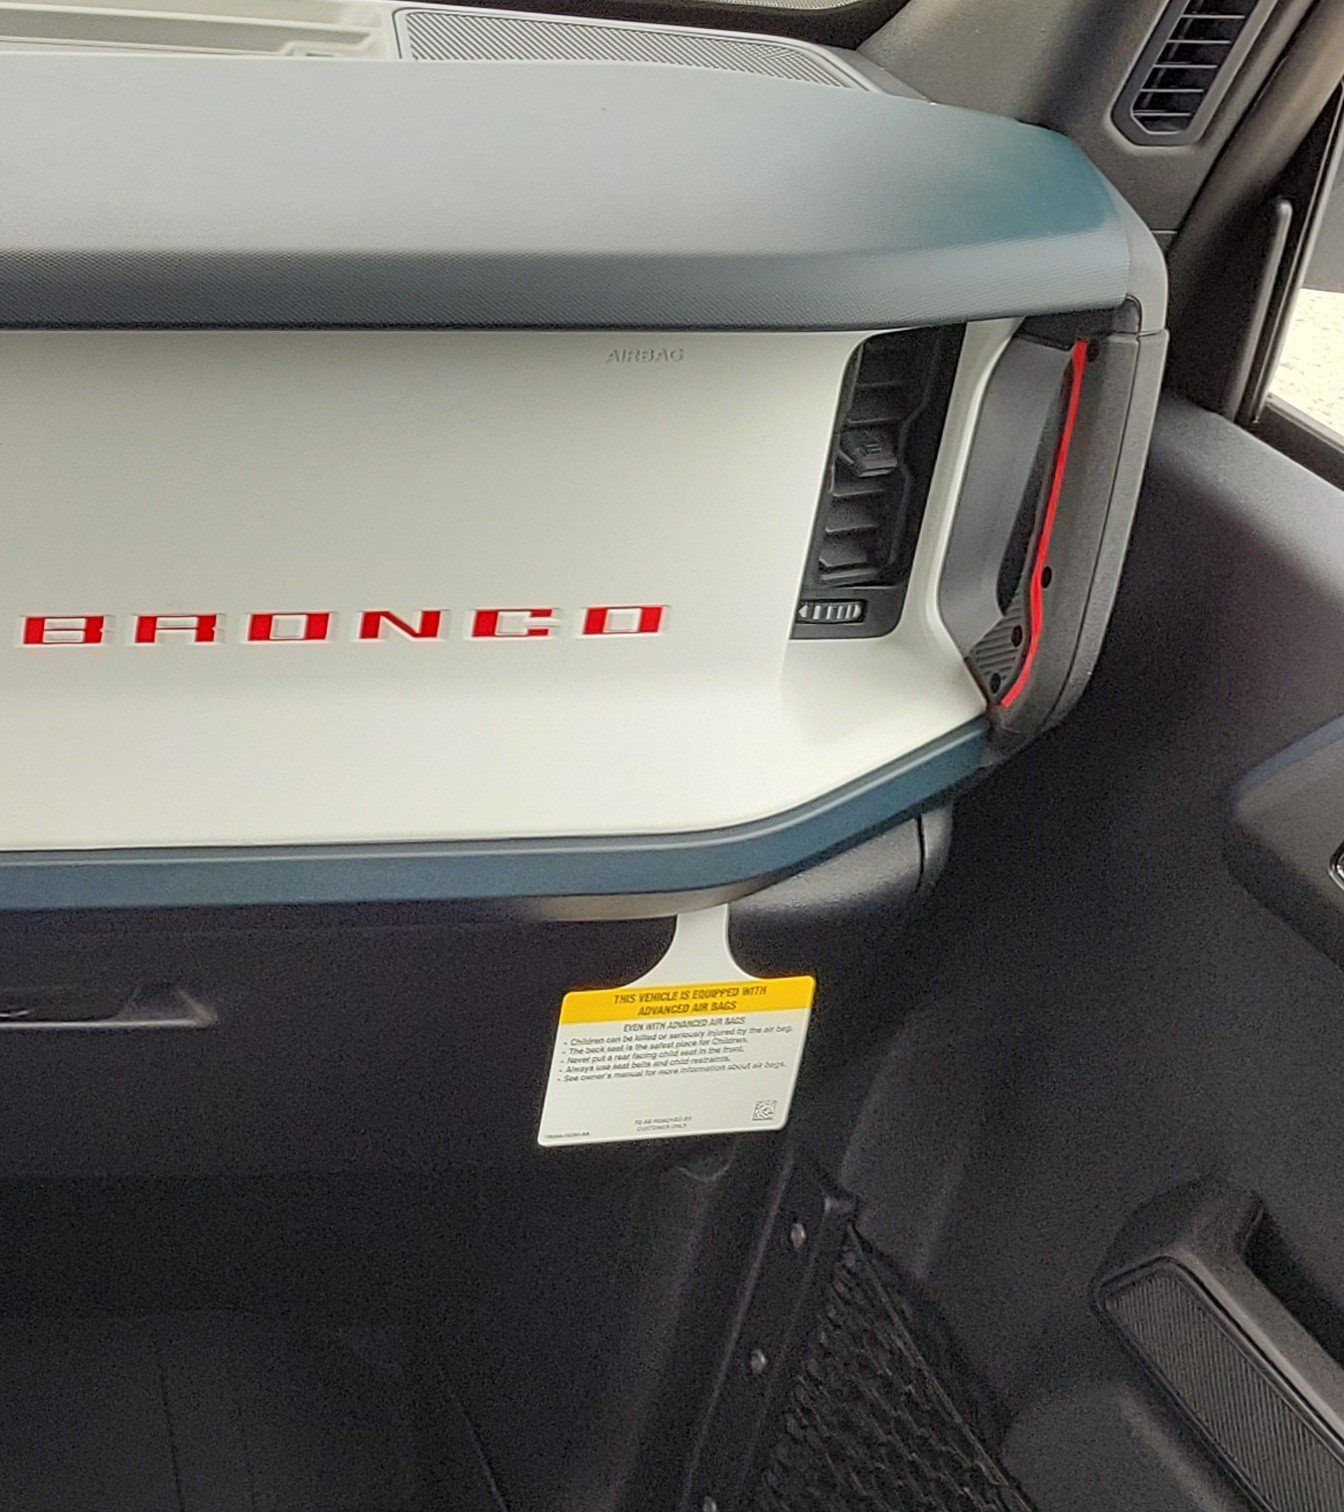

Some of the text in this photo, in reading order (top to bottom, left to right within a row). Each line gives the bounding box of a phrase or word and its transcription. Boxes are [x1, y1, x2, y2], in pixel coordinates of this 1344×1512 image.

[606, 348, 684, 362] AIRBAG
[21, 605, 666, 645] BRONCO
[614, 993, 635, 1005] THIS
[639, 991, 677, 1003] VEHICLE
[692, 986, 739, 999] EQUIPPED
[742, 984, 766, 996] WITH
[637, 999, 736, 1017] ADVANCED AIR BAGS
